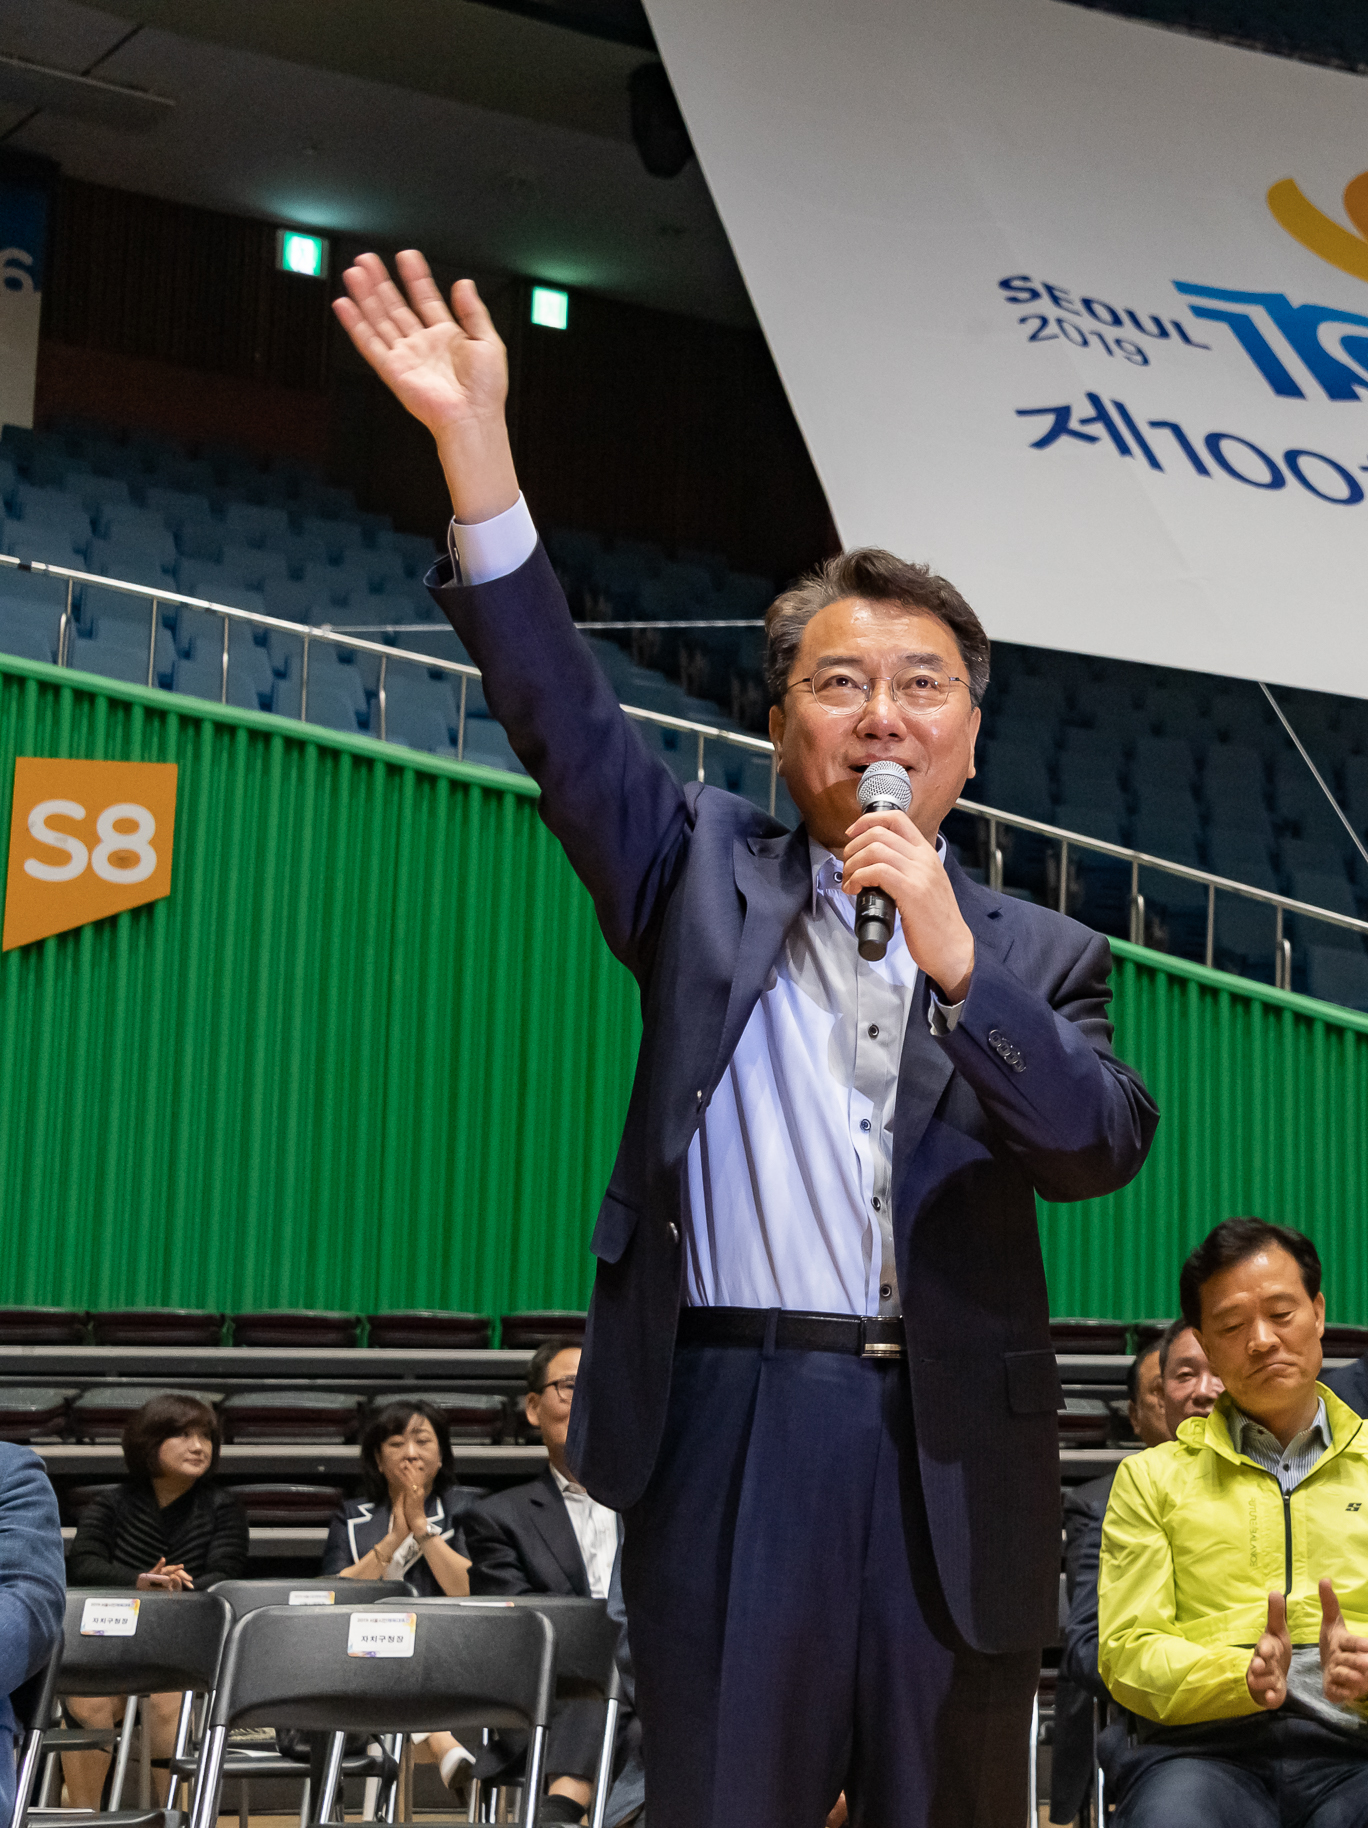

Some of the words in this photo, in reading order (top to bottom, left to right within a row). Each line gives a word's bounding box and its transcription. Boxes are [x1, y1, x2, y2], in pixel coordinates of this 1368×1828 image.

[998, 274, 1212, 351] SEOUL
[1017, 313, 1150, 367] 2019
[23, 798, 158, 885] S8
[361, 1635, 404, 1644] 자치구청장
